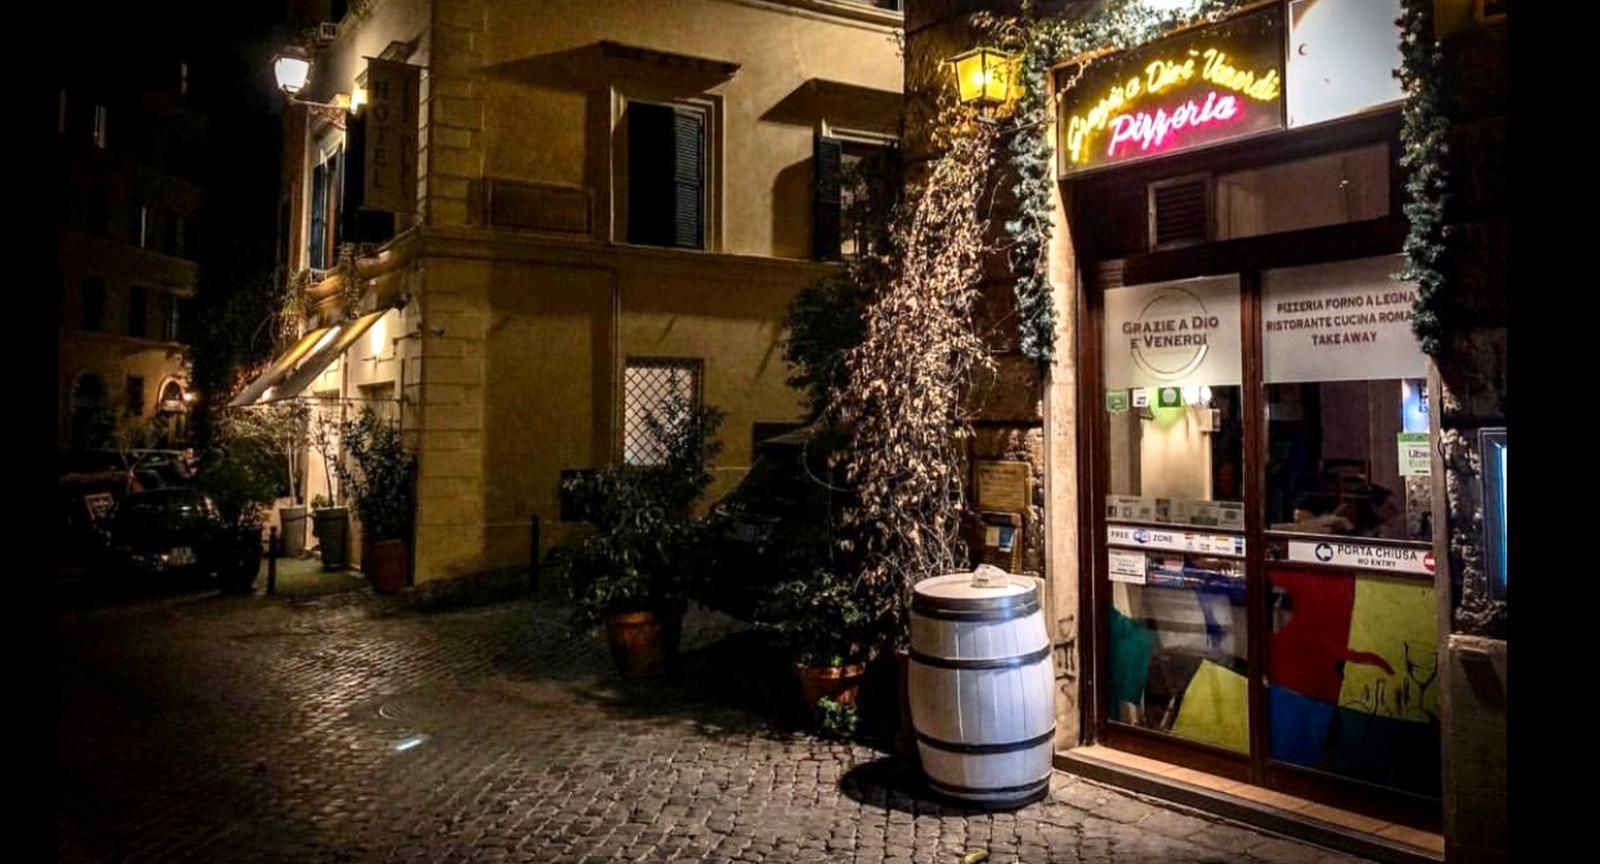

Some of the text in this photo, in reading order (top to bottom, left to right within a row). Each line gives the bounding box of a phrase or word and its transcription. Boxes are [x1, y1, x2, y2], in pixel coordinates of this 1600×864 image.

[1107, 91, 1238, 156] Pizzeria
[372, 79, 391, 189] HOTEL
[1277, 291, 1416, 313] PIZZERIA FORNO A LEGNA
[1122, 316, 1219, 335] GRAZIE A DIO
[1266, 310, 1413, 332] RISTORANTE CUCINA ROMA
[1153, 534, 1174, 543] ZONE
[1337, 543, 1418, 561] PORTA CHIUSA
[1357, 558, 1397, 568] NO ENTRY
